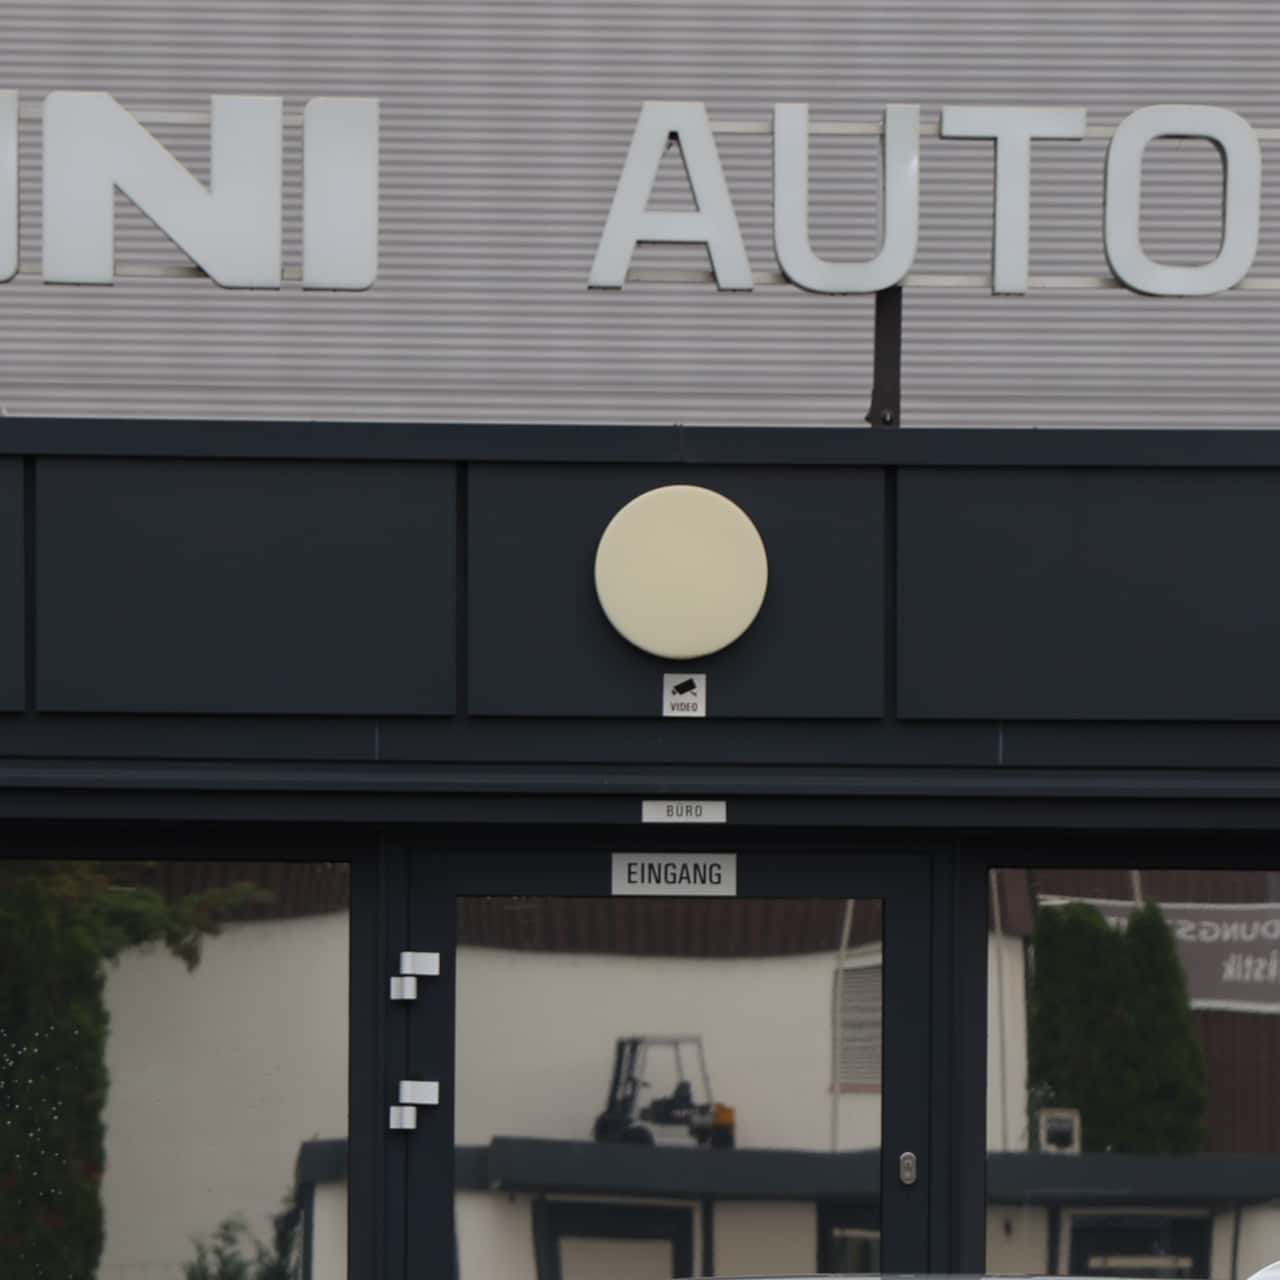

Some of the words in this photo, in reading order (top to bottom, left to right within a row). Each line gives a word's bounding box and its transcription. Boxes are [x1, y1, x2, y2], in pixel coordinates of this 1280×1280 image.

[587, 101, 1264, 298] AUTO
[670, 702, 698, 712] VIDEO
[627, 862, 722, 885] EINGANG
